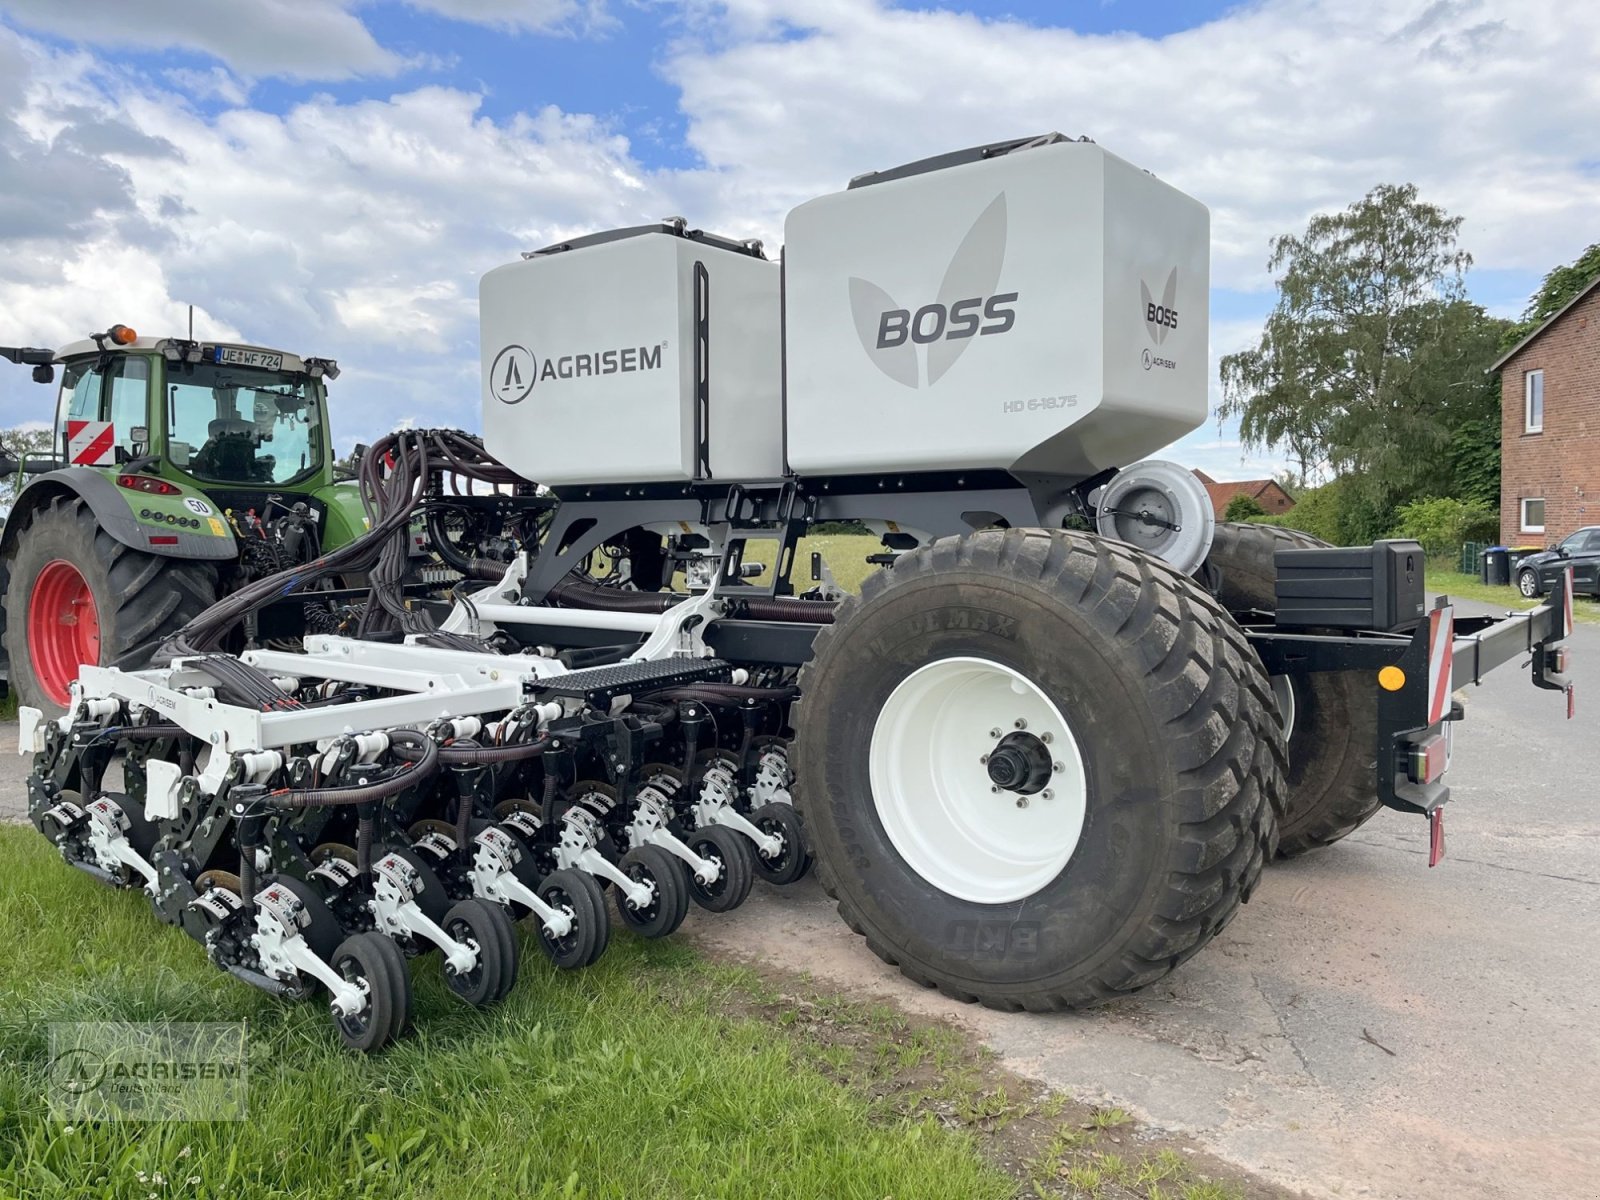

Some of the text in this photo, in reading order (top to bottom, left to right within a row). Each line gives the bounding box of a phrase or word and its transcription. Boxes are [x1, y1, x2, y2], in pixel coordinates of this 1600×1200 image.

[876, 292, 1018, 349] BOSS
[1147, 303, 1178, 329] BOSS
[223, 350, 280, 368] UE WF 724
[1003, 395, 1078, 413] HD 6-18.75
[187, 499, 209, 513] 50
